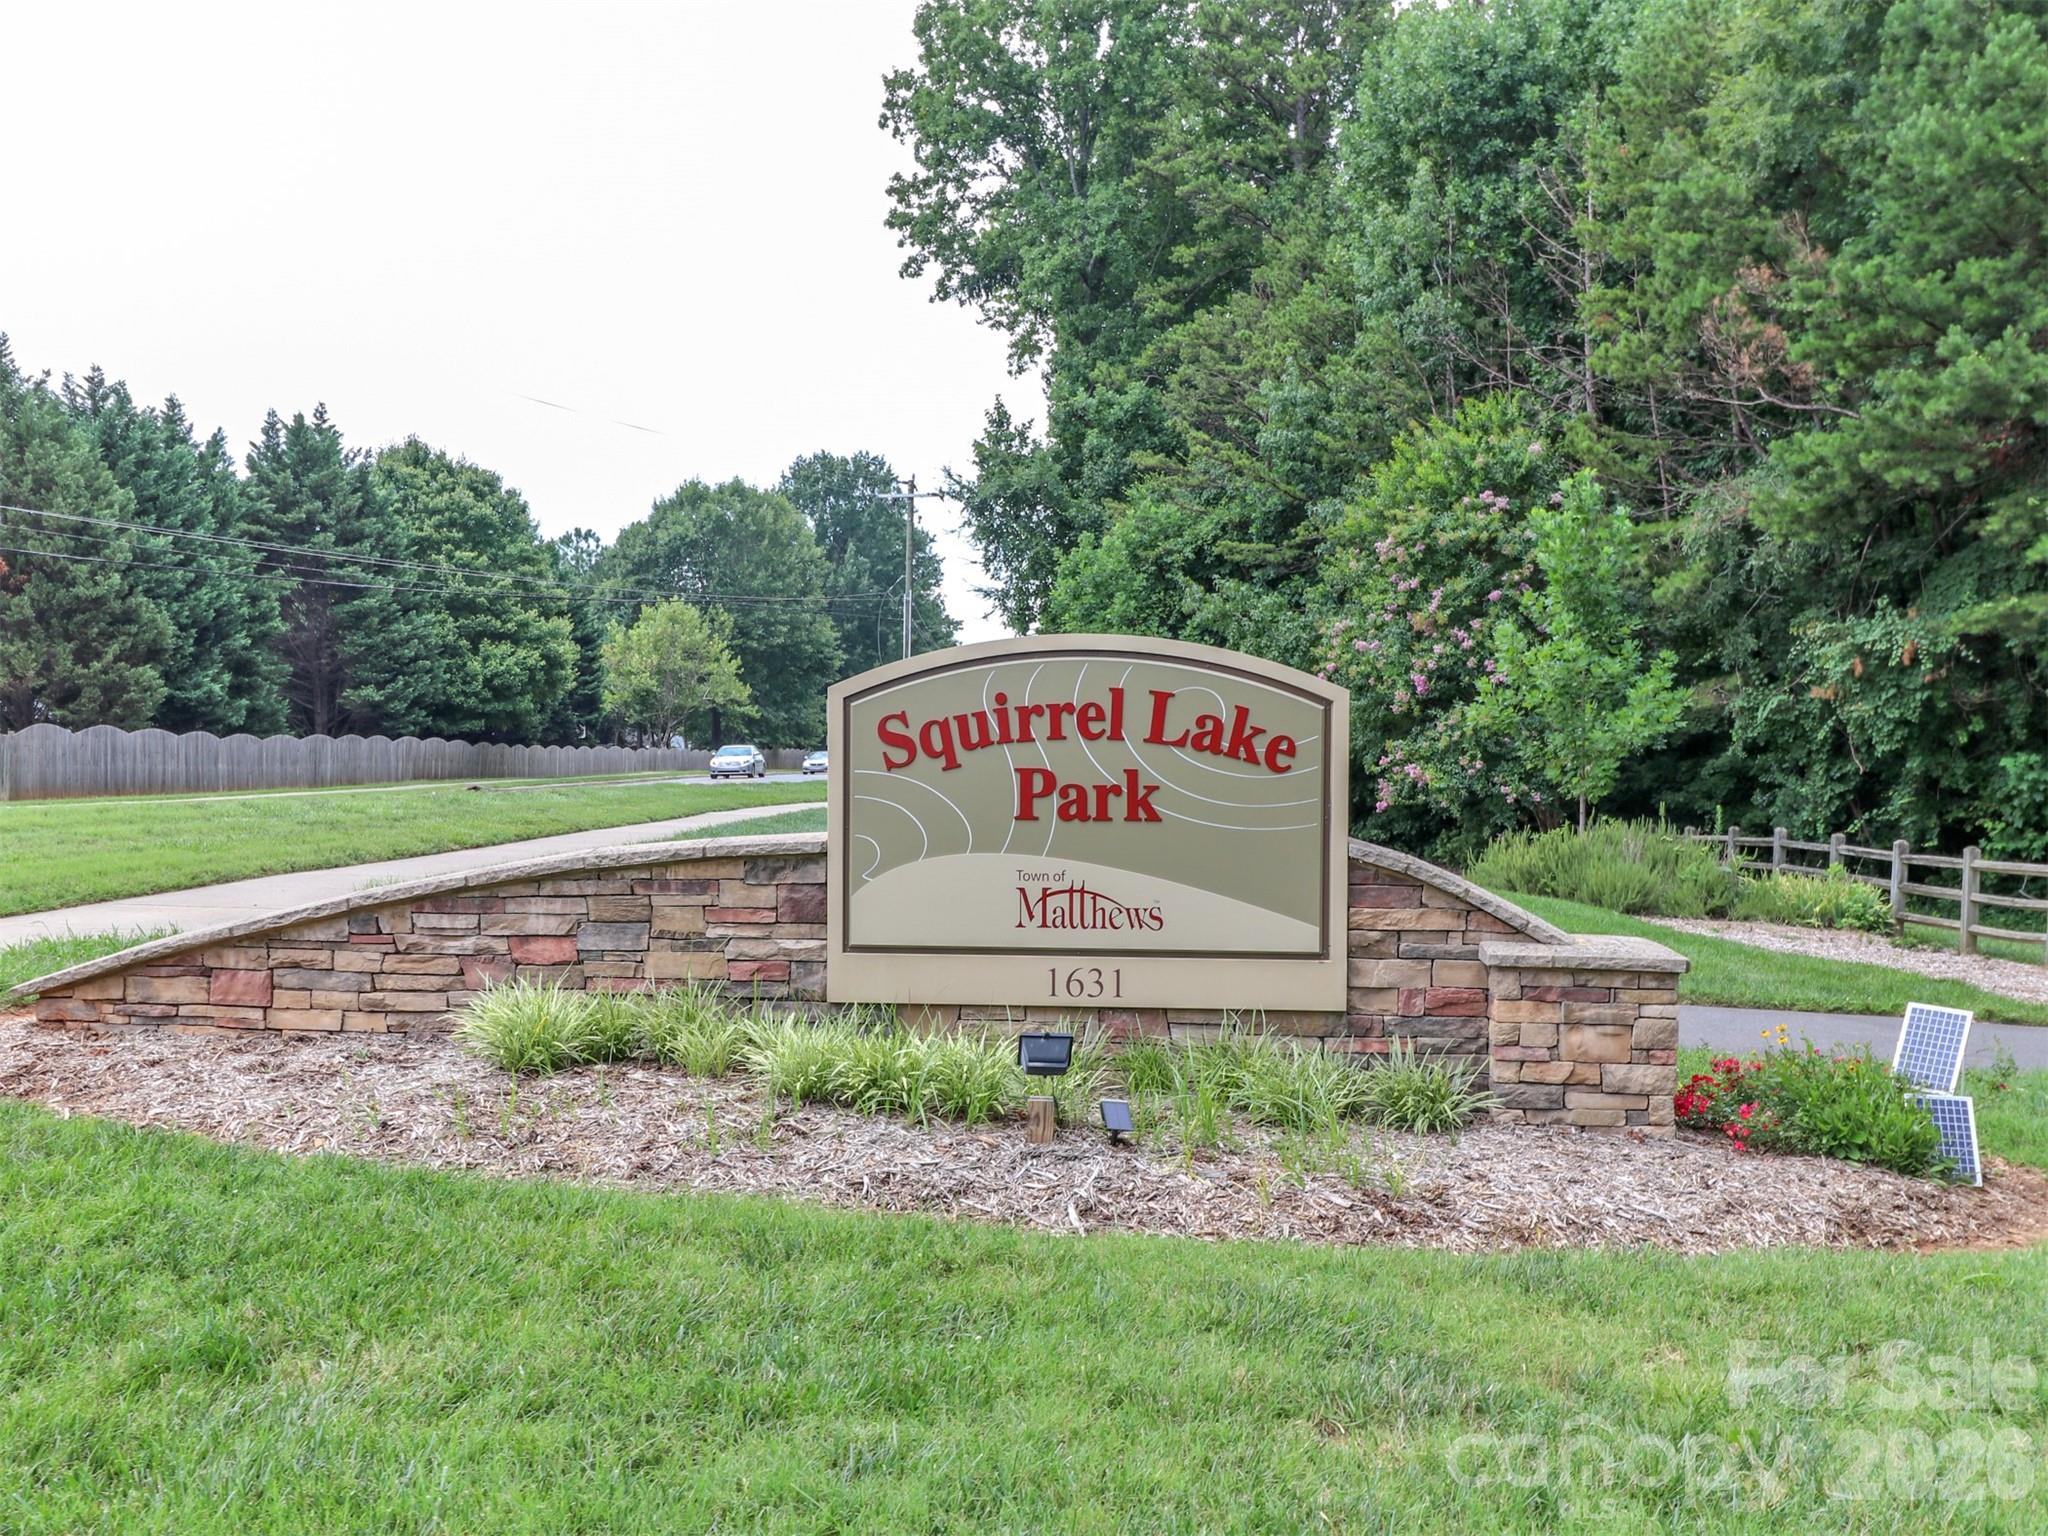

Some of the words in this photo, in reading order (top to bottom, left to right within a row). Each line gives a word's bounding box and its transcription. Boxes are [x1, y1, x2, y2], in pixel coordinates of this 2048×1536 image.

[876, 686, 1124, 772] Squirrel
[1144, 689, 1297, 774] Lake
[1014, 766, 1162, 822] Park
[1016, 869, 1050, 882] Town
[1053, 869, 1067, 882] of
[1014, 880, 1164, 932] Matthews
[1047, 967, 1124, 998] 1631
